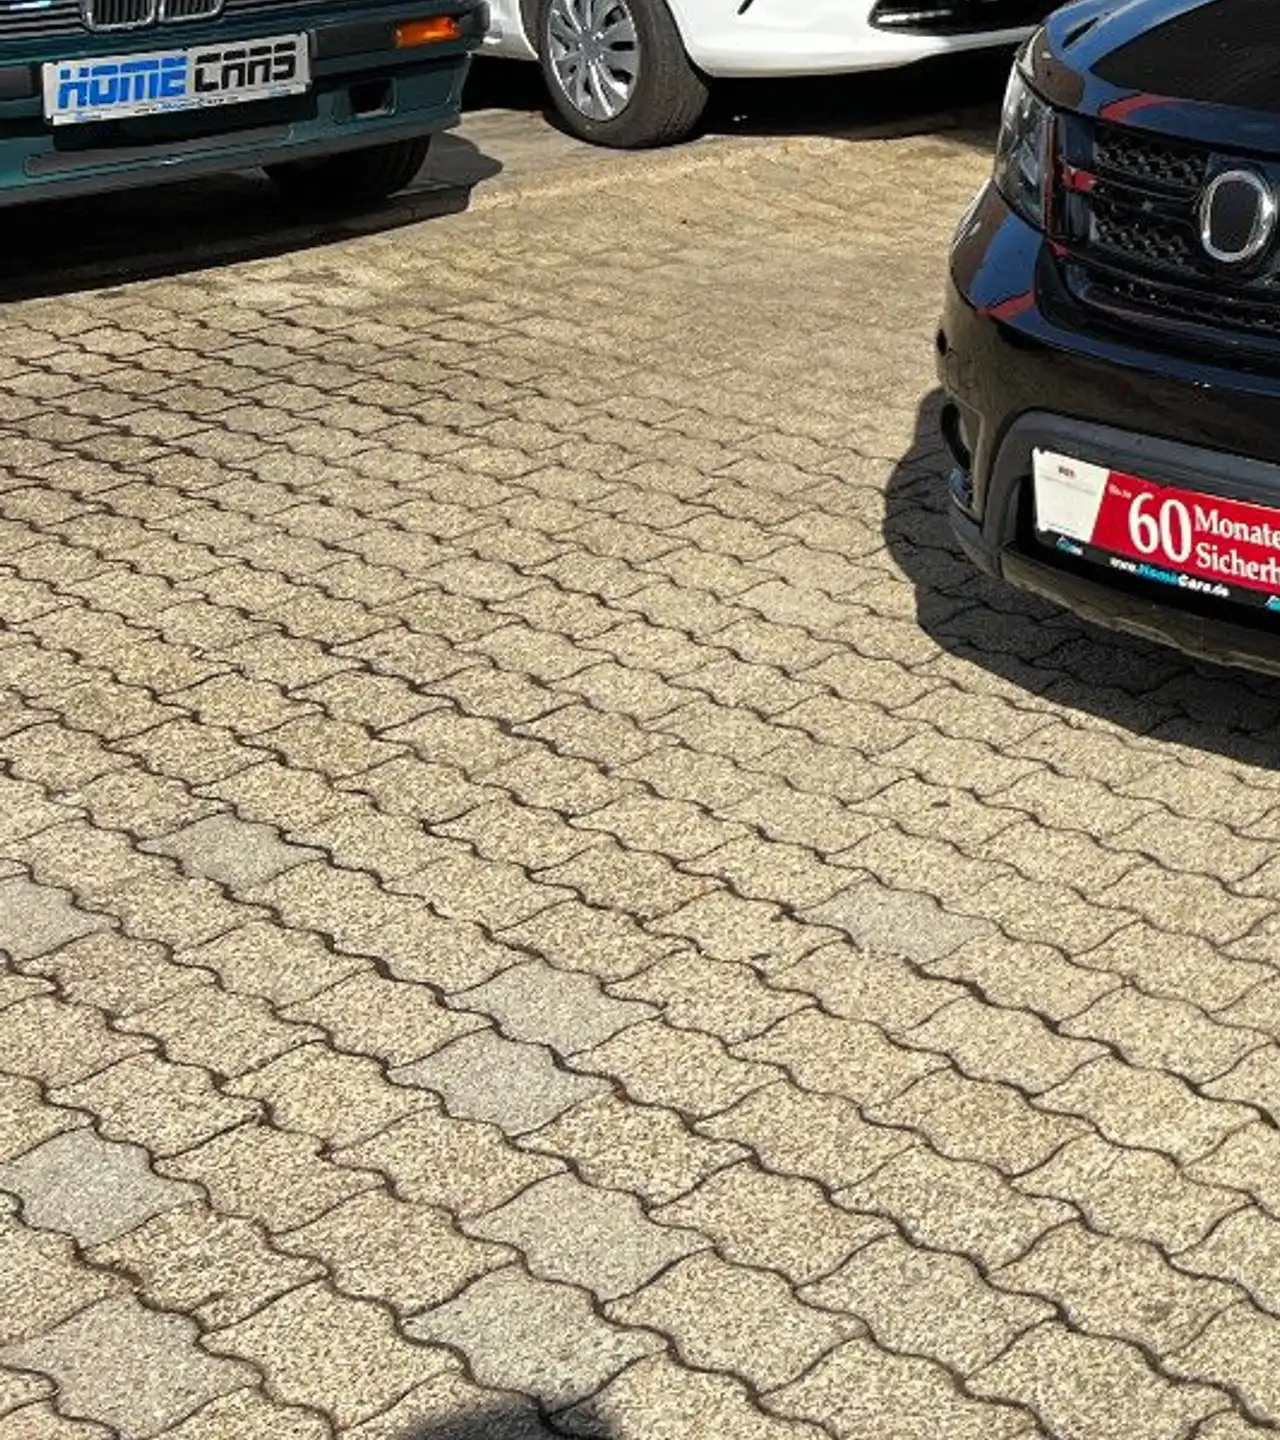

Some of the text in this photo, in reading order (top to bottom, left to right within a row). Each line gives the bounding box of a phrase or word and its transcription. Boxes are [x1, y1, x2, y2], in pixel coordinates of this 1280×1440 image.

[58, 40, 298, 110] HOME CARS
[1128, 491, 1192, 563] 60
